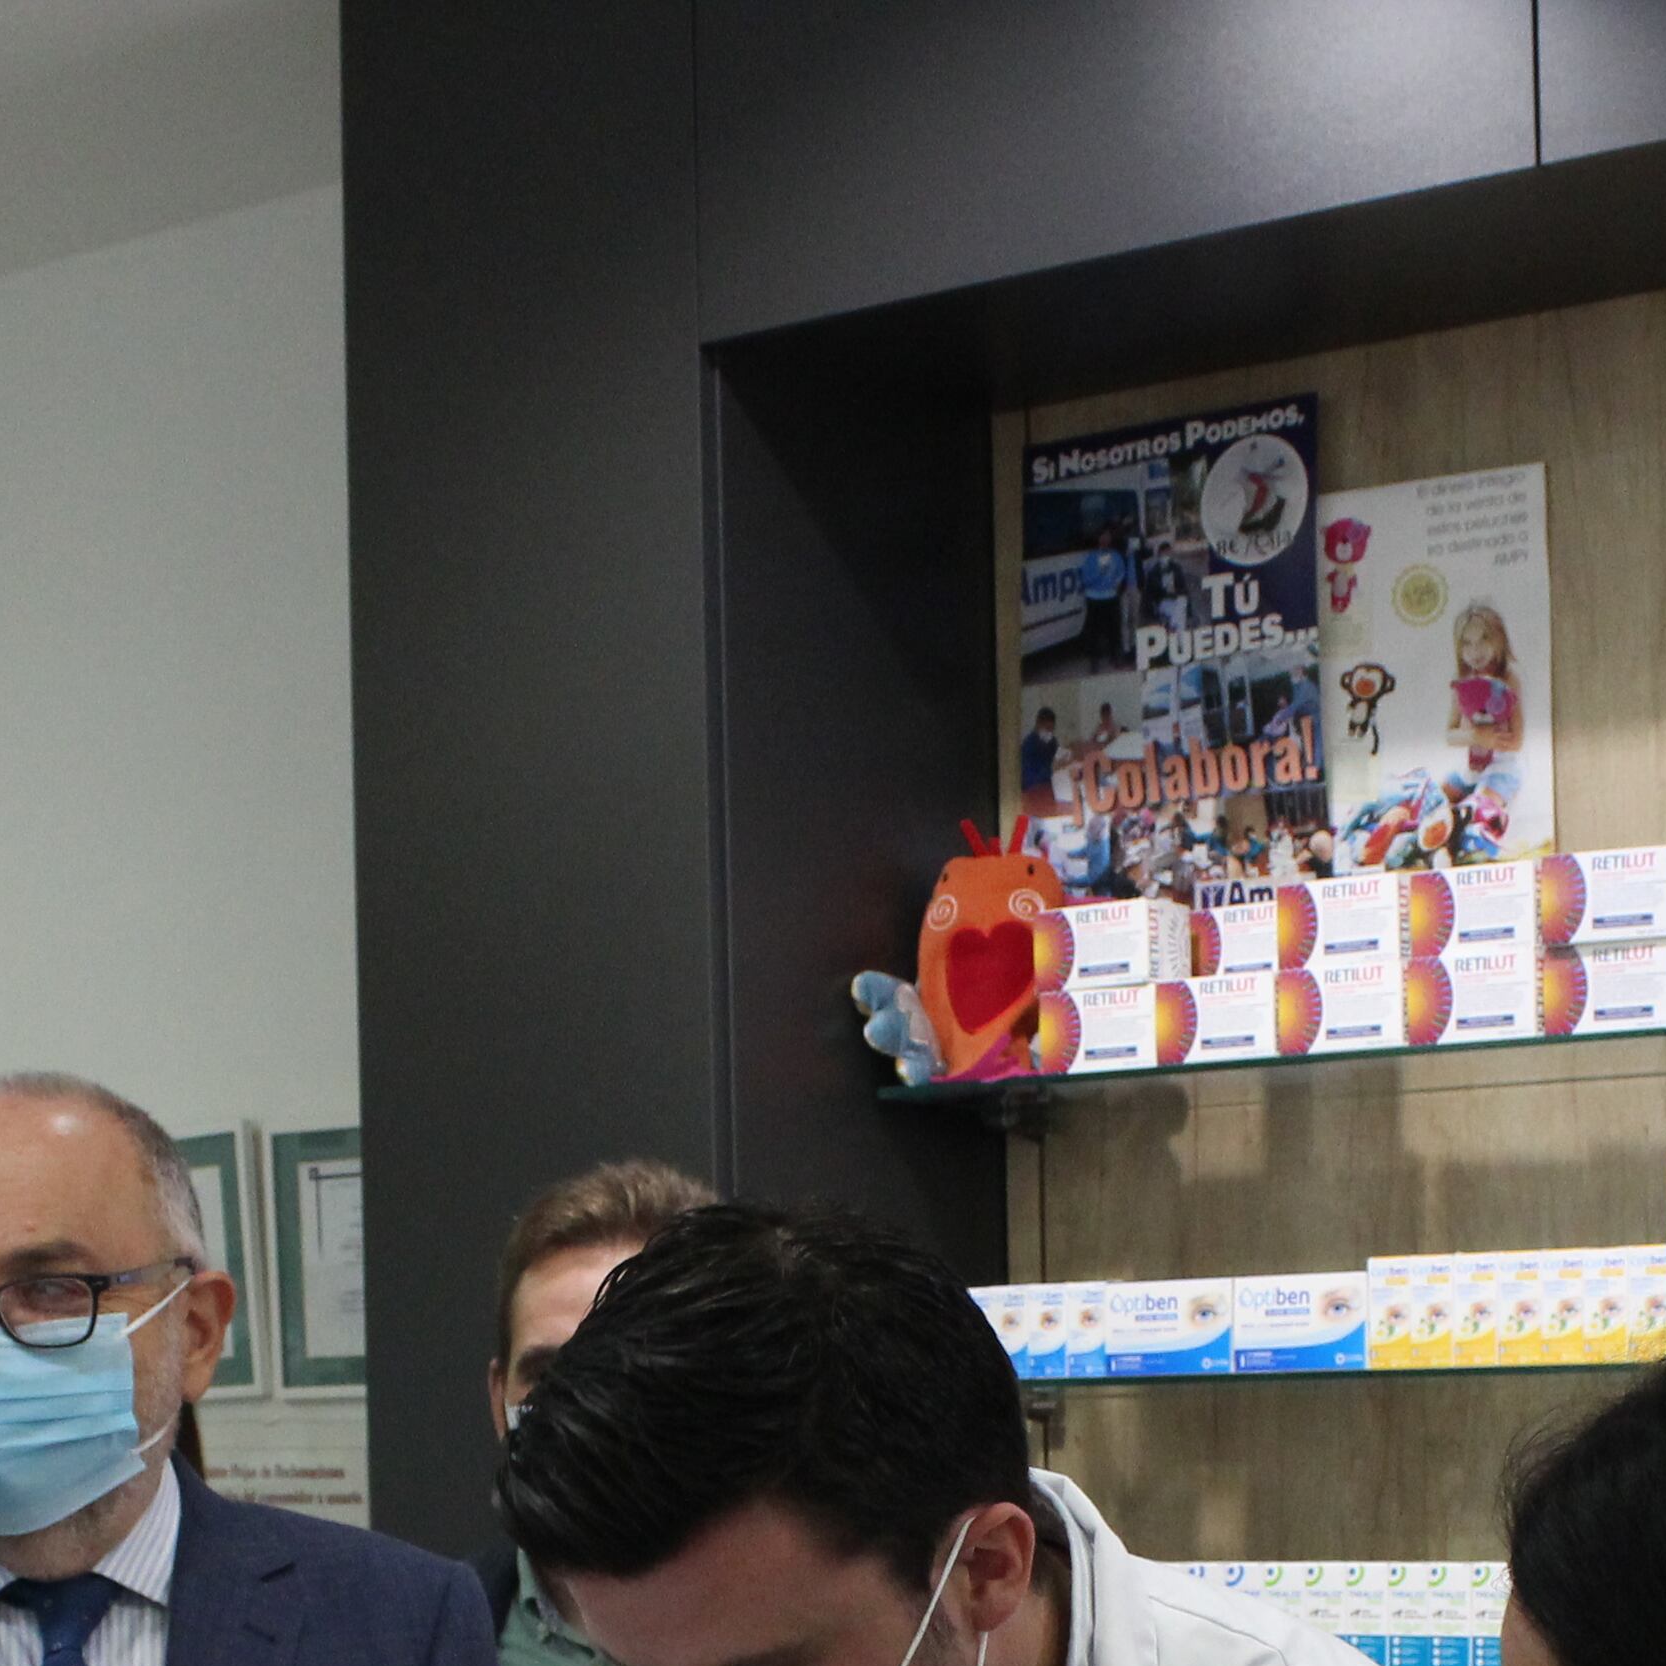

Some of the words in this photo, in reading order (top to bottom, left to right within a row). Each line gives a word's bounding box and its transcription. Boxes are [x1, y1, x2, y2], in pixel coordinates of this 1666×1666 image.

[1067, 715, 1319, 827] ¡Colabora!
[1592, 852, 1656, 871] RETILUT
[1456, 867, 1516, 886] RETILUT
[1322, 880, 1380, 899] RETILUT
[1076, 907, 1131, 924] RETILUT
[1455, 954, 1517, 972] RETILUT
[1324, 965, 1385, 983] RETILUT
[1199, 978, 1258, 995] RETILUT
[1083, 989, 1139, 1007] RETILUT
[1110, 1293, 1179, 1318] Optiben
[1239, 1287, 1311, 1311] Optiben
